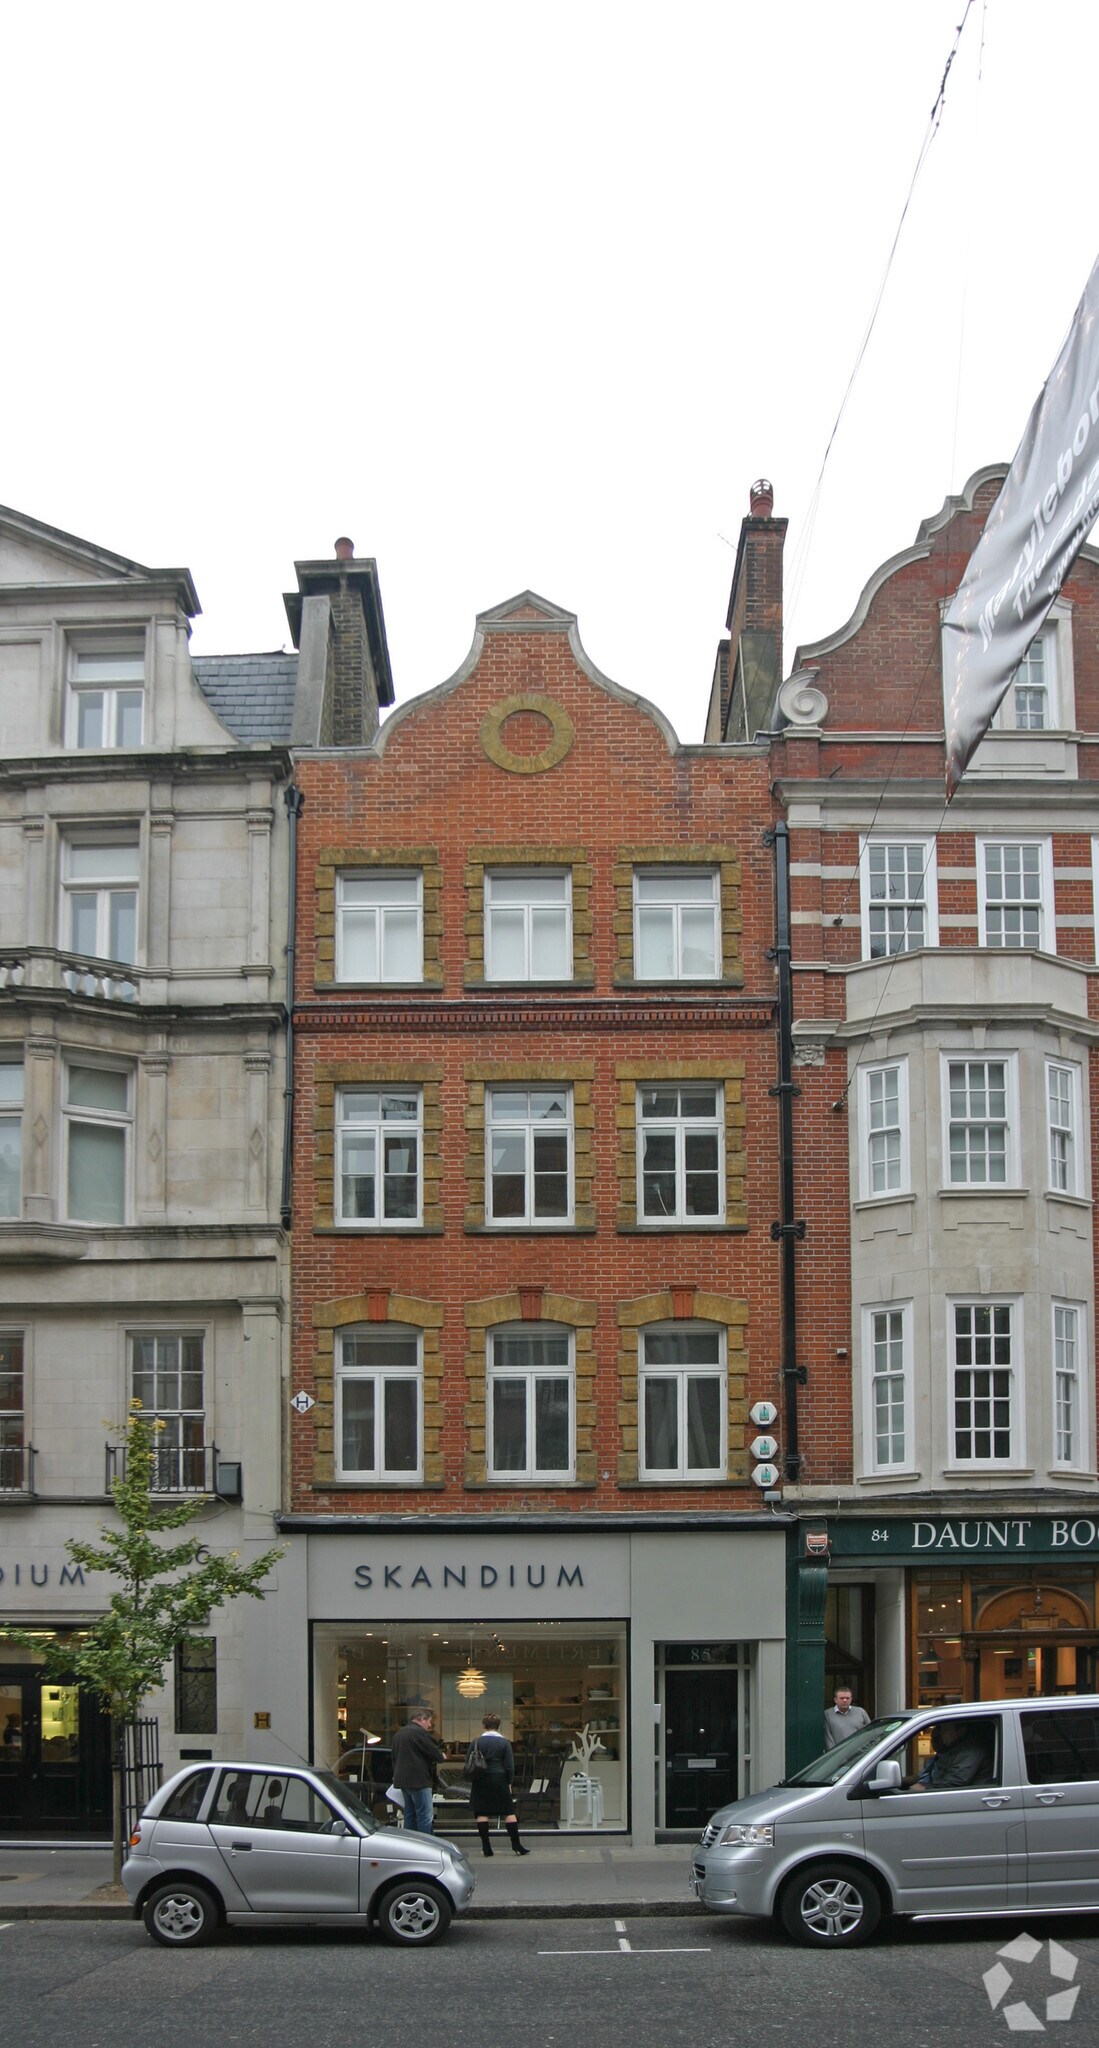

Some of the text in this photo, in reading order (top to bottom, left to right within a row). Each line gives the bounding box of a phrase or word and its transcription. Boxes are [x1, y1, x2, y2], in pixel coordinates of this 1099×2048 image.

[871, 1519, 1099, 1548] 84 DAUNT BO
[0, 1563, 85, 1586] IUM
[354, 1564, 584, 1588] SKANDIUM
[691, 1647, 711, 1661] 85
